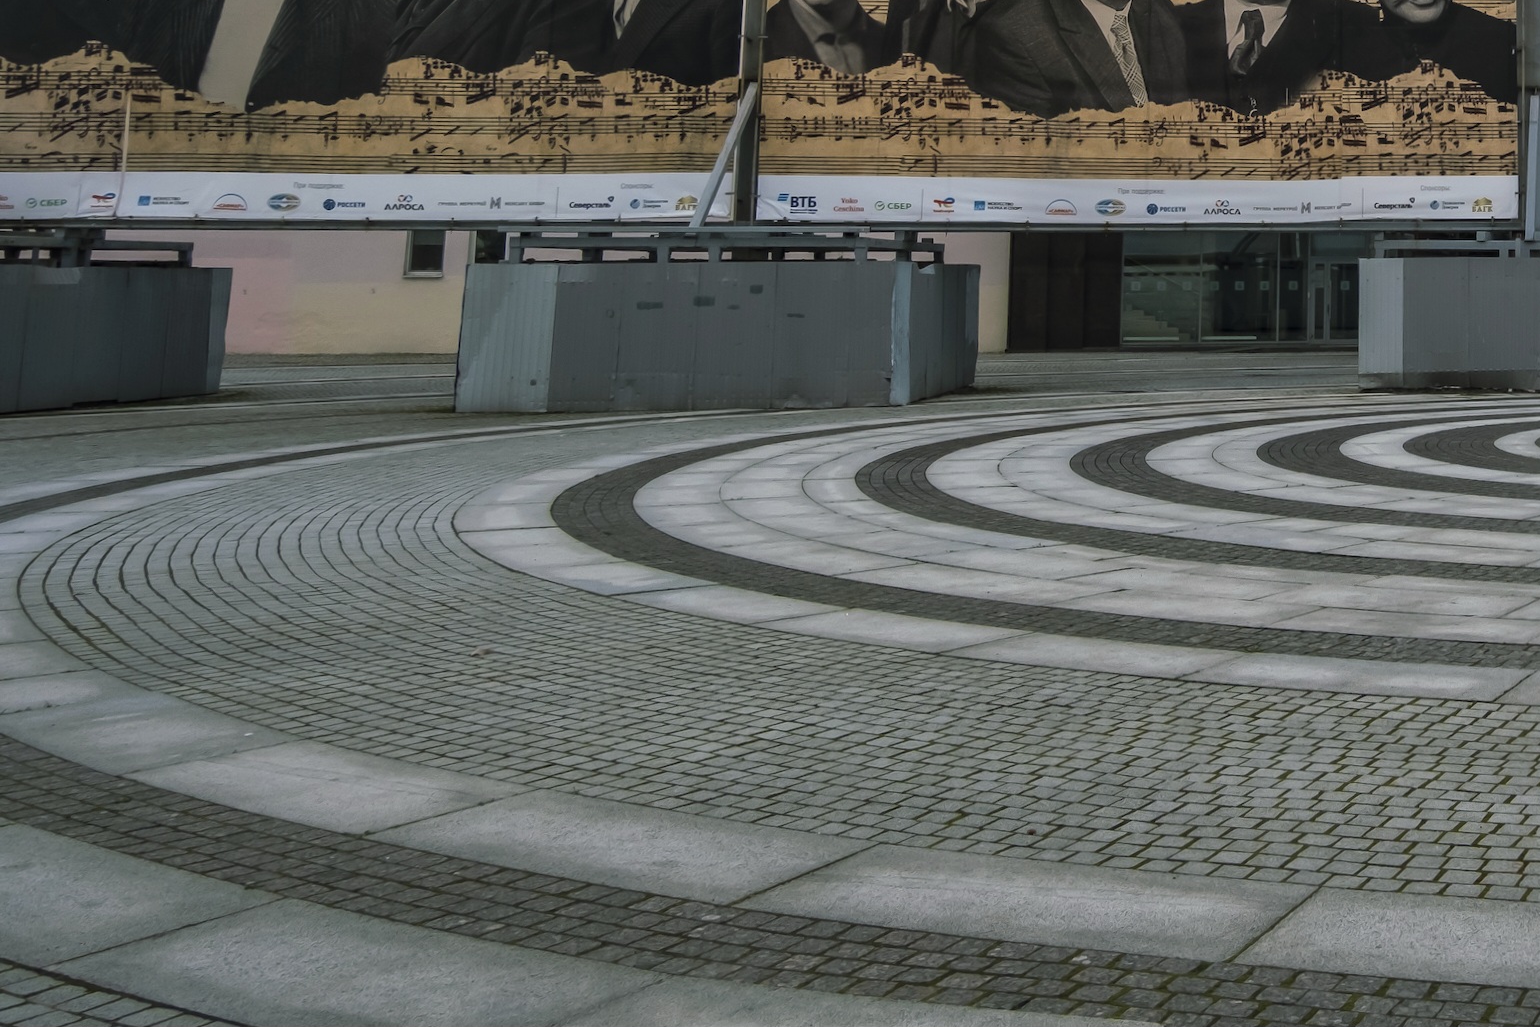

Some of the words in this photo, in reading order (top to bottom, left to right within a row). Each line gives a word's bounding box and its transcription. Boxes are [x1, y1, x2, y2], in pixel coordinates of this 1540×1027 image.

[39, 198, 68, 207] СБЕР
[569, 201, 612, 210] Северсталь
[790, 196, 817, 208] ВТБ
[887, 202, 912, 210] СБЕР
[1374, 202, 1413, 210] Северсталь
